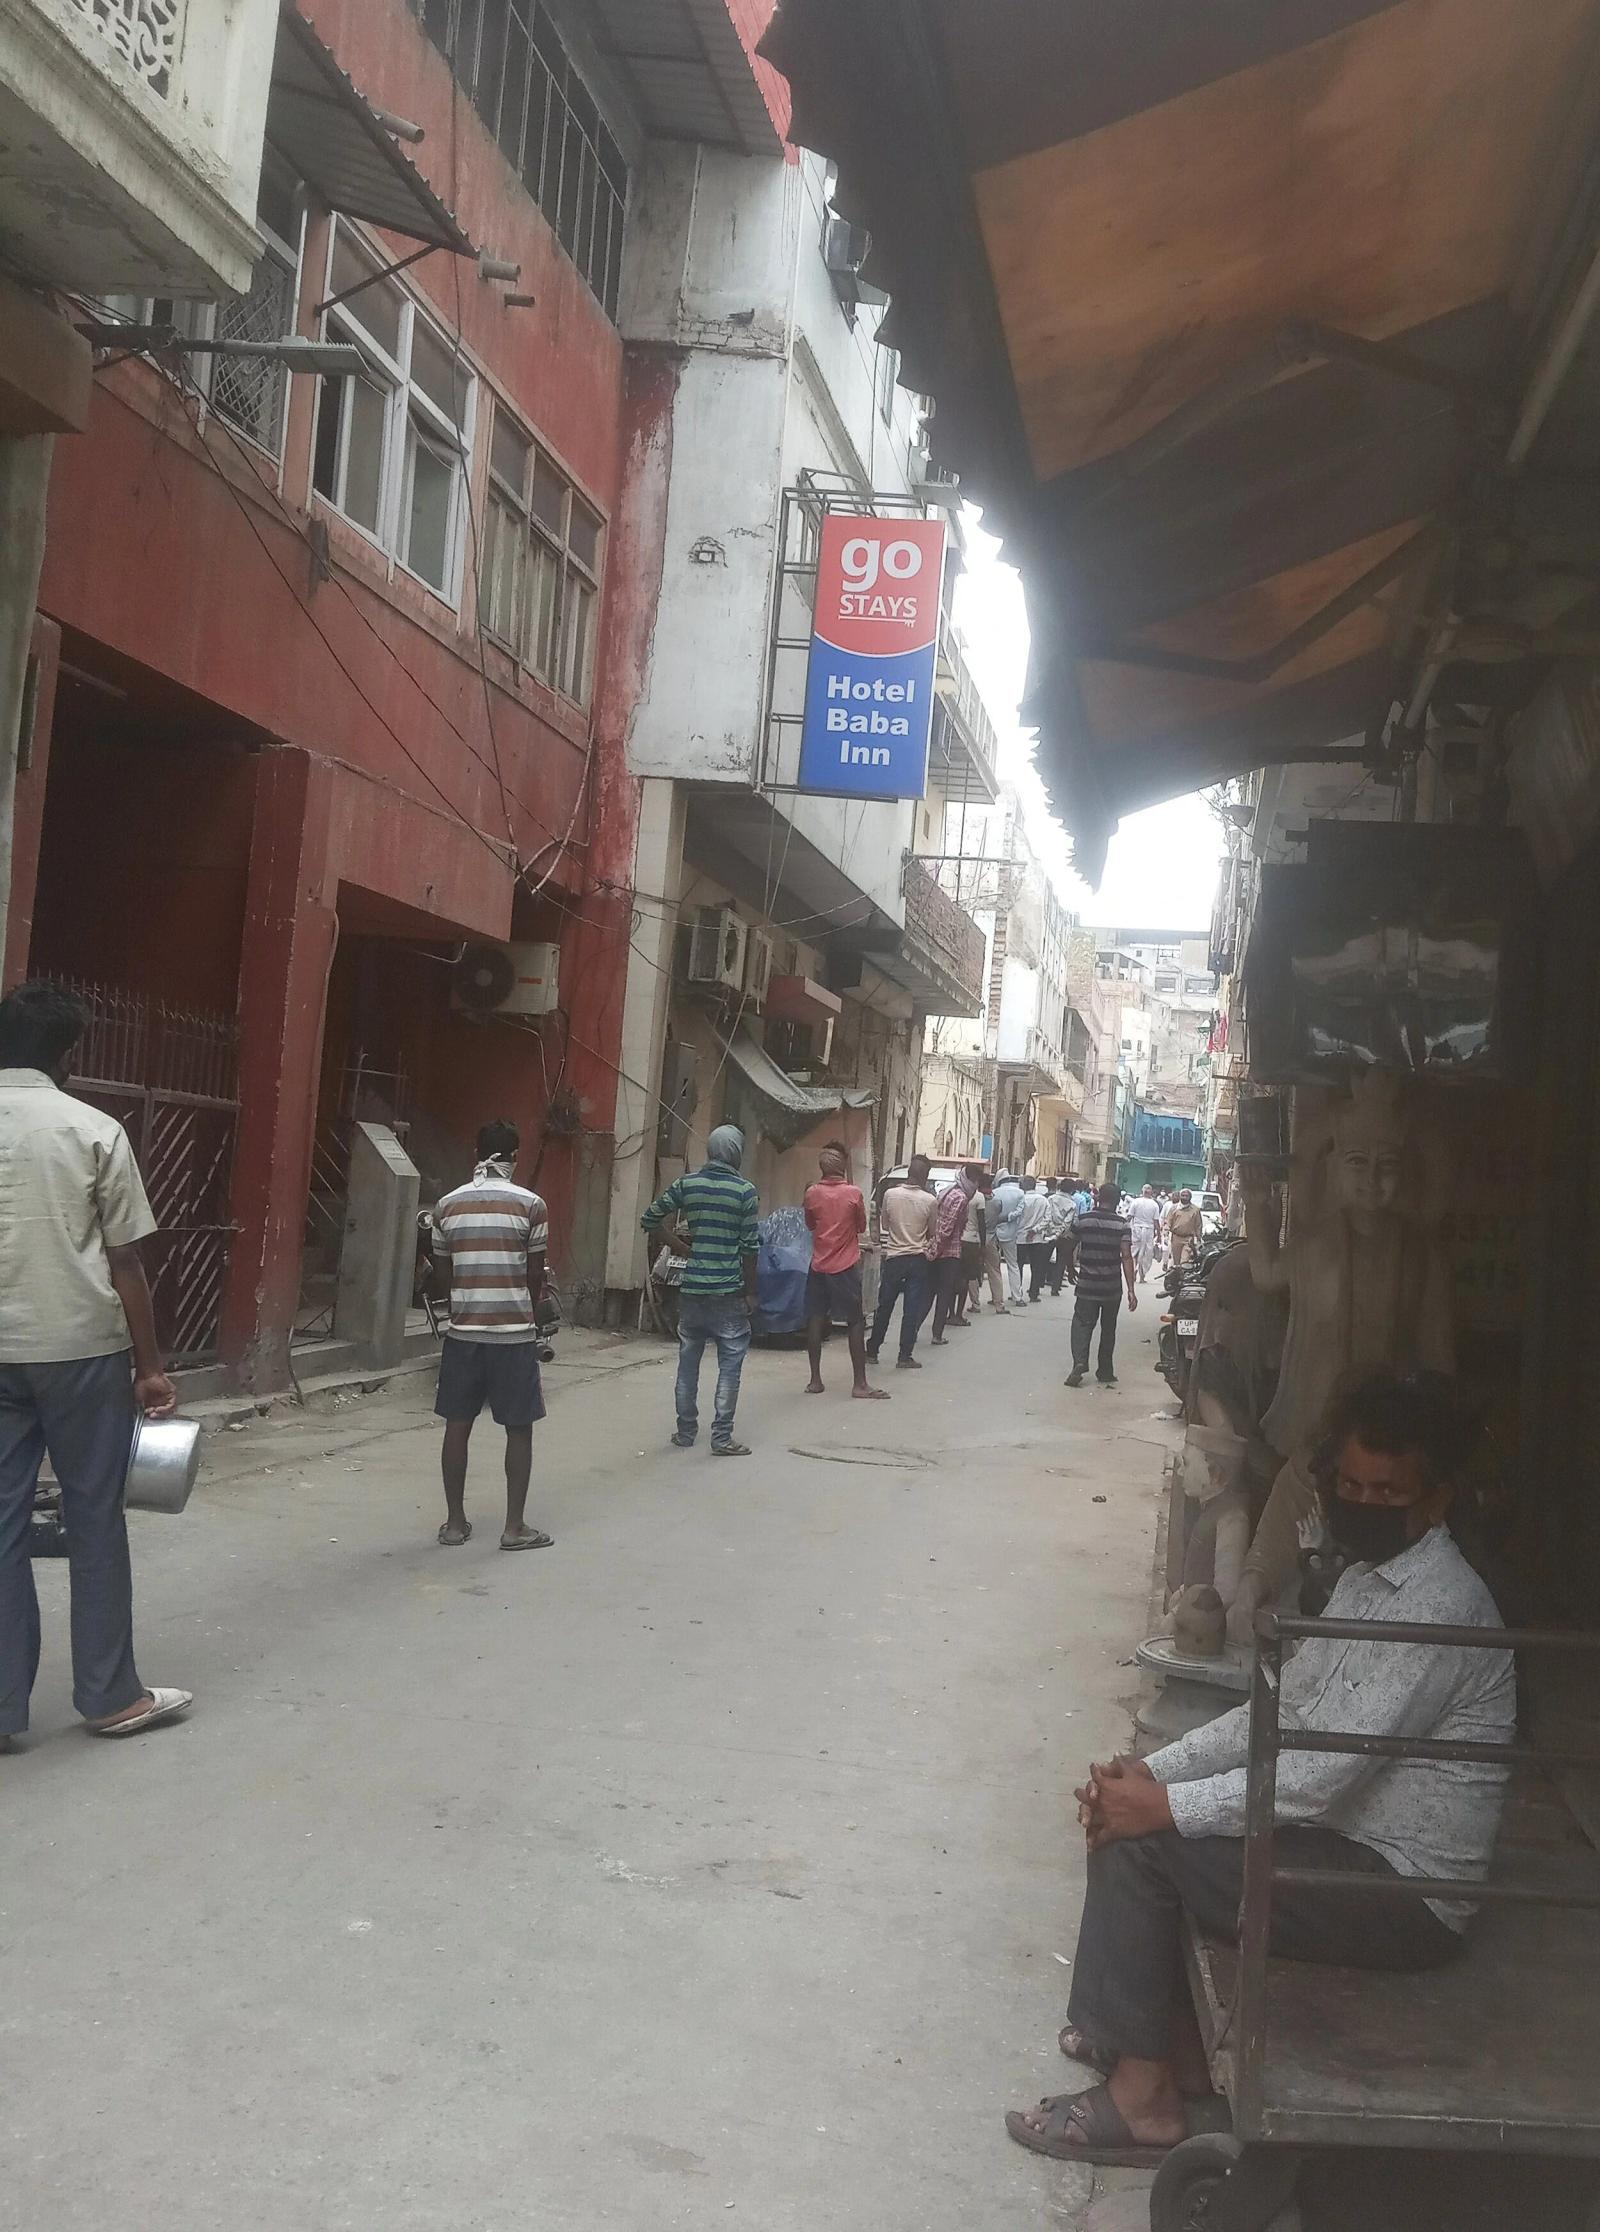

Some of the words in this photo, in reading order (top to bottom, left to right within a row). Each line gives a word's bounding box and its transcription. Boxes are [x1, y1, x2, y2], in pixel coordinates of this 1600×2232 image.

[841, 537, 922, 593] go
[839, 593, 918, 619] STAYS
[827, 674, 916, 704] Hotel
[826, 707, 910, 736] Baba
[840, 739, 891, 767] Inn
